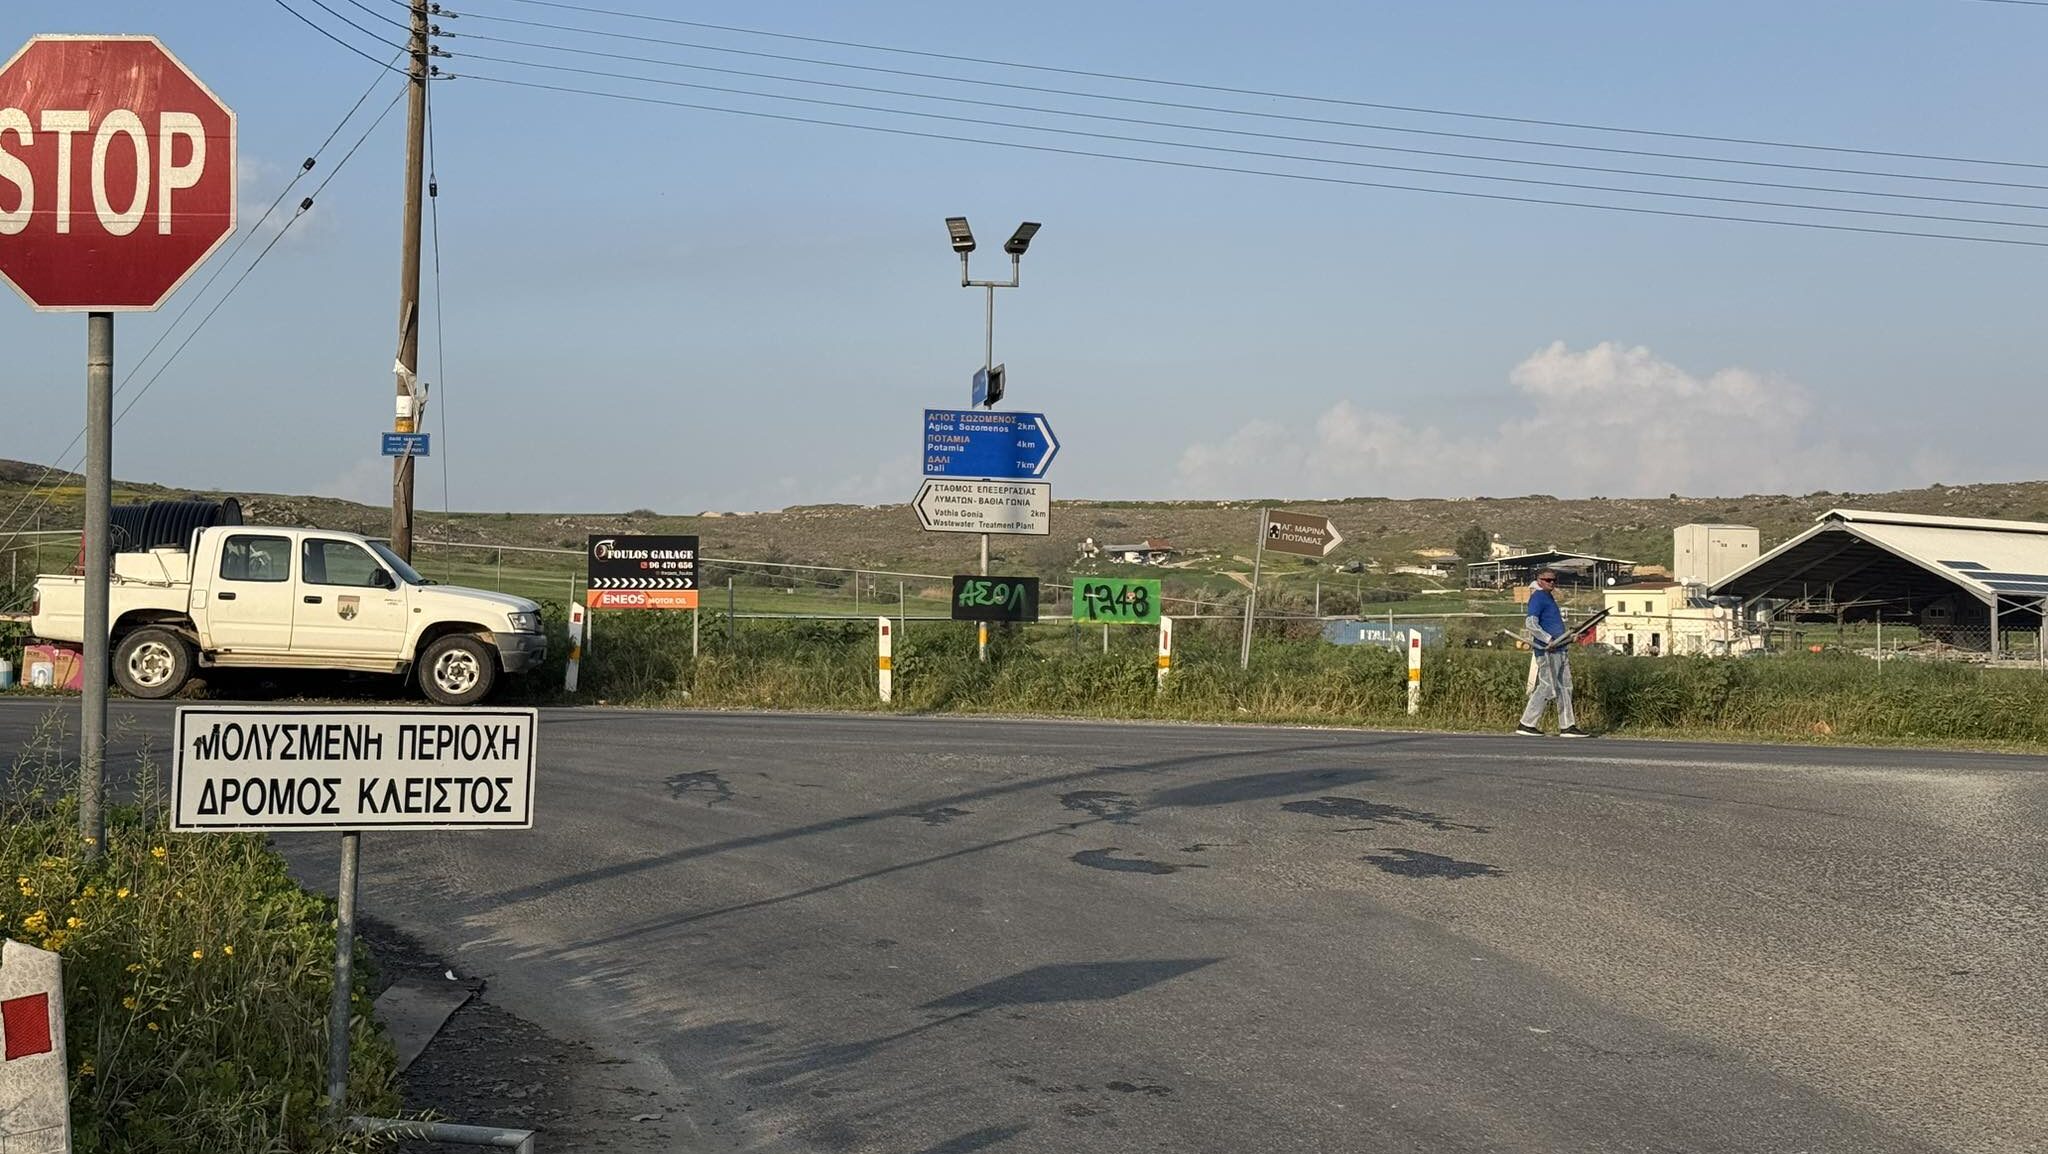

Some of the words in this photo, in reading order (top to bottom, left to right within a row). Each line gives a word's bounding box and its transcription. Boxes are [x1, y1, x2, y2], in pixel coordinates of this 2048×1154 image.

[0, 107, 207, 237] STOP
[928, 413, 956, 421] ΑΓΙΟΣ
[960, 414, 1017, 424] ΣΩΖΟΜΕΝΟΣ
[928, 422, 954, 431] Agios
[959, 423, 1009, 433] Sozomenos
[1017, 422, 1036, 431] 2km
[928, 434, 971, 443] ΠΟΤΑΜΙΑ
[927, 443, 965, 452] Potamia
[1016, 440, 1036, 449] 4km
[928, 455, 951, 463] ΔΑΛΙ
[1016, 460, 1035, 469] 7km
[927, 464, 945, 472] Dali
[934, 484, 973, 493] ΣΤΑΘΜΟΣ
[977, 485, 1037, 496] ΕΠΕΞΕΡΓΑΣΙΑΣ
[978, 497, 1004, 506] ΒΑΘΙΑ
[1005, 498, 1031, 507] ΓΩΝΙΑ
[934, 508, 959, 517] Vathia
[960, 509, 984, 519] Gonia
[1030, 509, 1047, 518] 2km
[933, 518, 975, 528] Wastewater
[978, 520, 1014, 530] Treatment
[1015, 521, 1036, 530] Plant
[1294, 524, 1326, 537] ΜΑΡΙΝΑ
[1281, 532, 1323, 546] ΠΟΤΑΜΙΑΣ
[650, 549, 694, 560] GARAGE
[661, 561, 677, 569] 470
[602, 594, 646, 605] ENEOS
[194, 723, 383, 761] ΜΟΛΥΣΜΕΝΗ
[398, 724, 521, 760] ΠΕΡΙΟΧΗ
[197, 777, 342, 816] ΔΡΟΜΟΣ
[357, 776, 514, 814] ΚΛΕΙΣΤΟΣ
